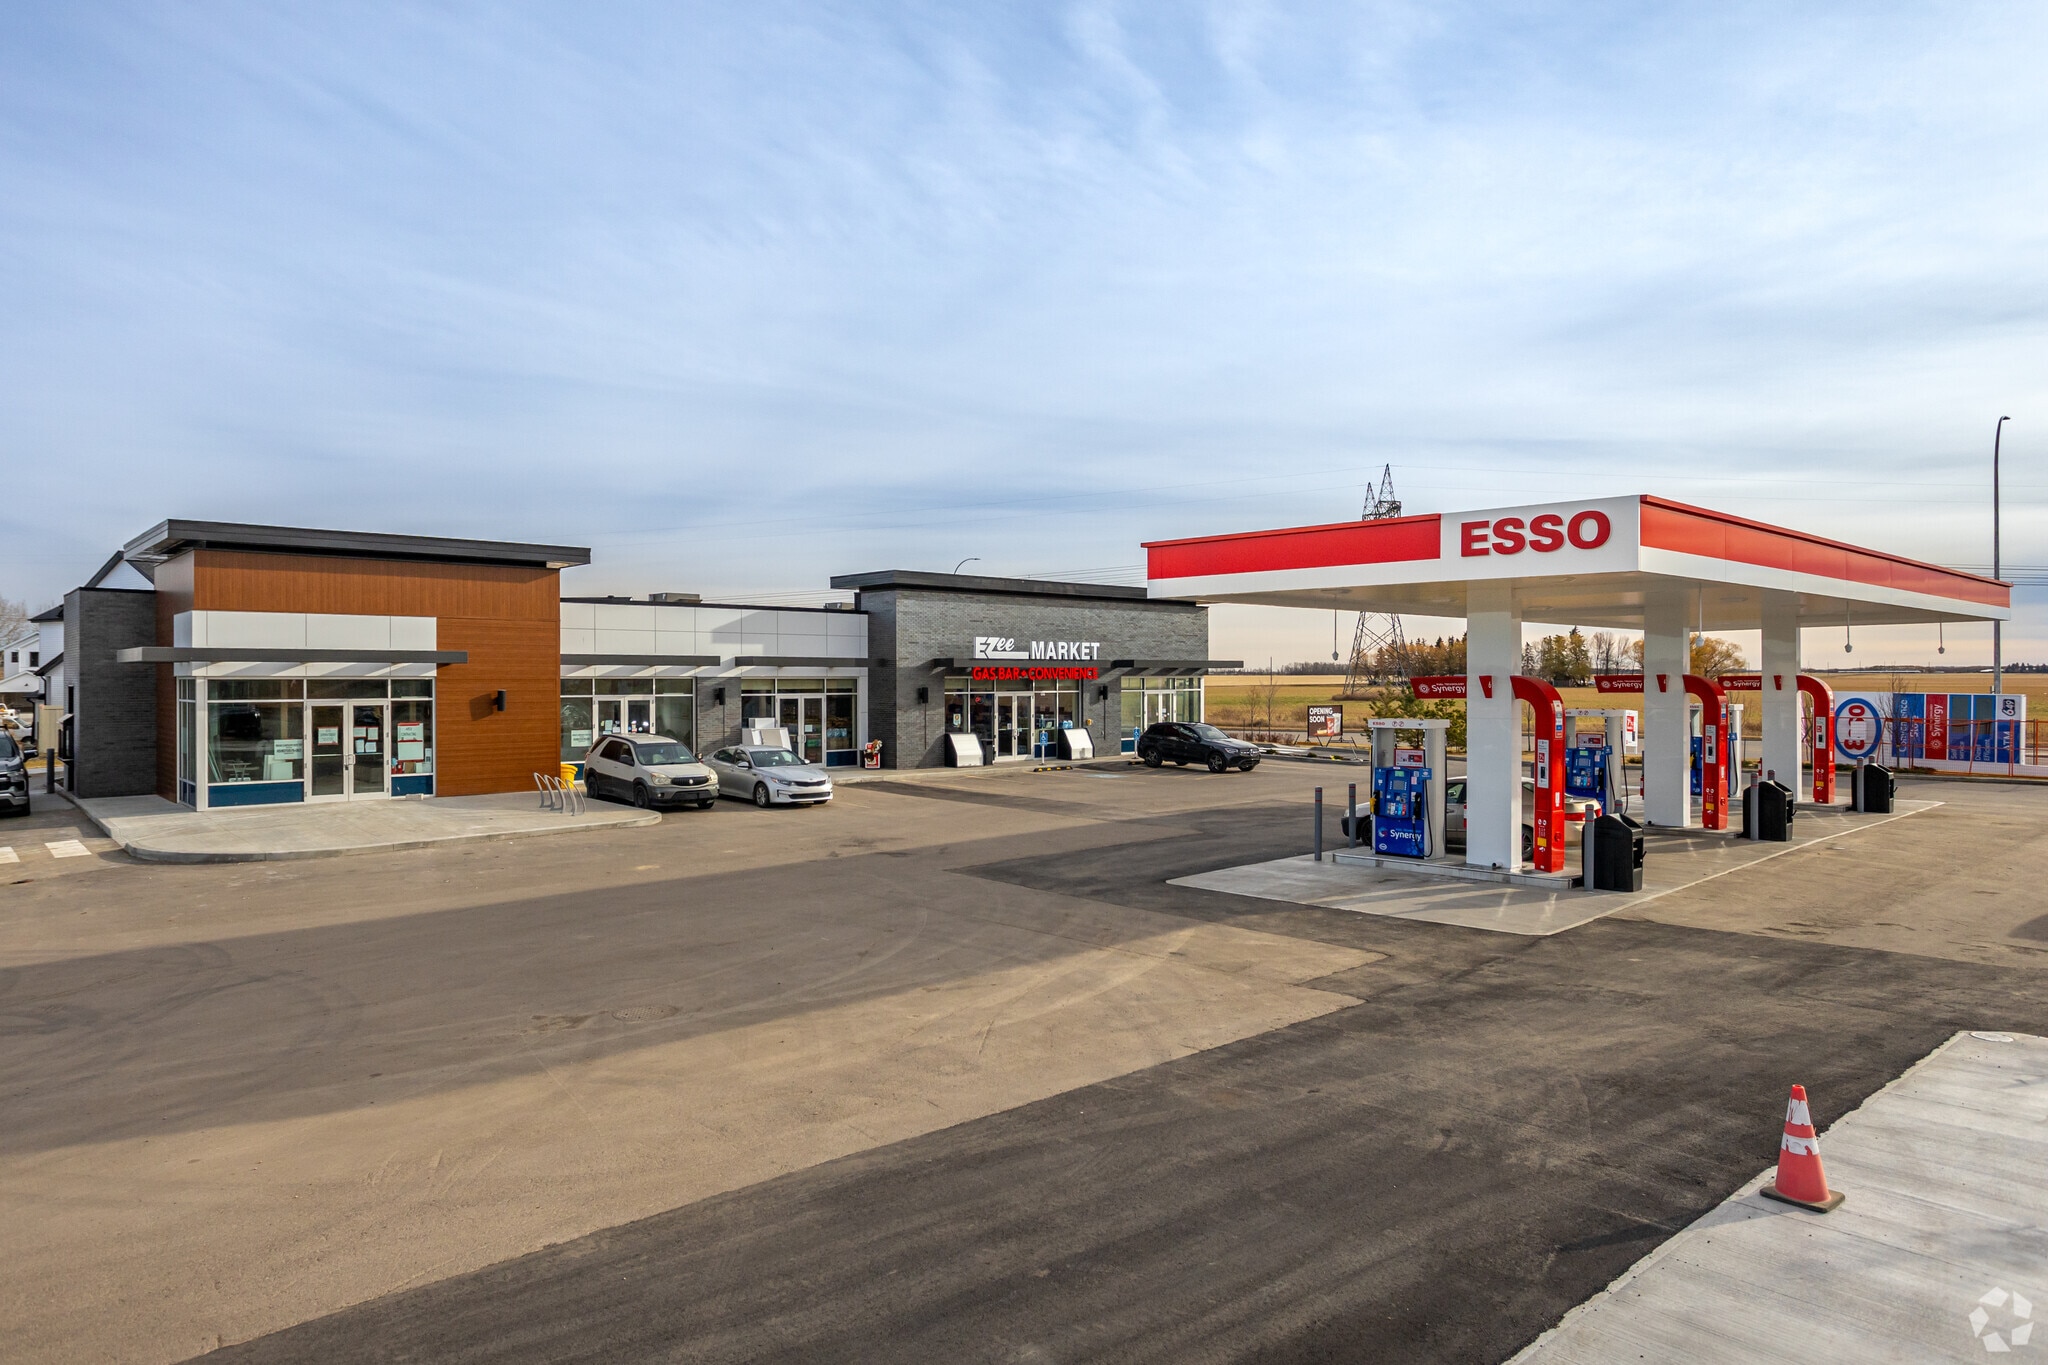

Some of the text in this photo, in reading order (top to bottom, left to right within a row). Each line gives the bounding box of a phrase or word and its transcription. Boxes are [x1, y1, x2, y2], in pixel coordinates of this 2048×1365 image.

[1460, 510, 1612, 558] ESSO
[1031, 641, 1100, 660] MARKET
[972, 666, 1098, 680] GAS BAR CONVENIENCE
[1431, 684, 1466, 694] Synergy
[1309, 707, 1333, 715] OPENING
[1931, 703, 1944, 737] Synergy
[2003, 731, 2012, 750] ATM
[1390, 829, 1422, 842] Synergy
